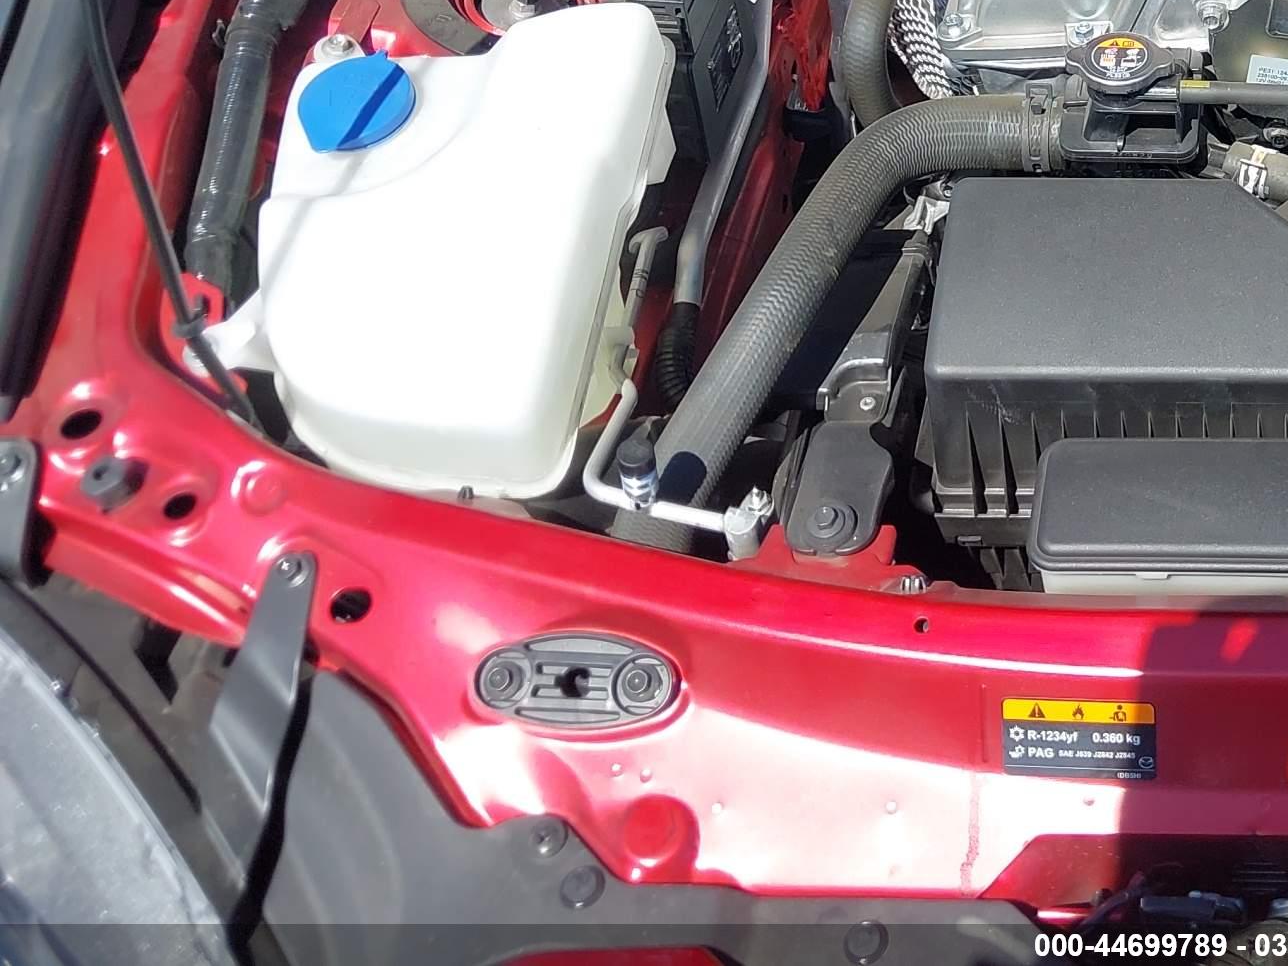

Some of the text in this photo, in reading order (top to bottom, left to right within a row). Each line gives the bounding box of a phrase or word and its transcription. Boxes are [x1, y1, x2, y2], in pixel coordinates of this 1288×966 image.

[1027, 729, 1141, 746] R-1234yf 0.360 kg
[1027, 746, 1055, 758] PAG
[1058, 749, 1074, 758] SAE
